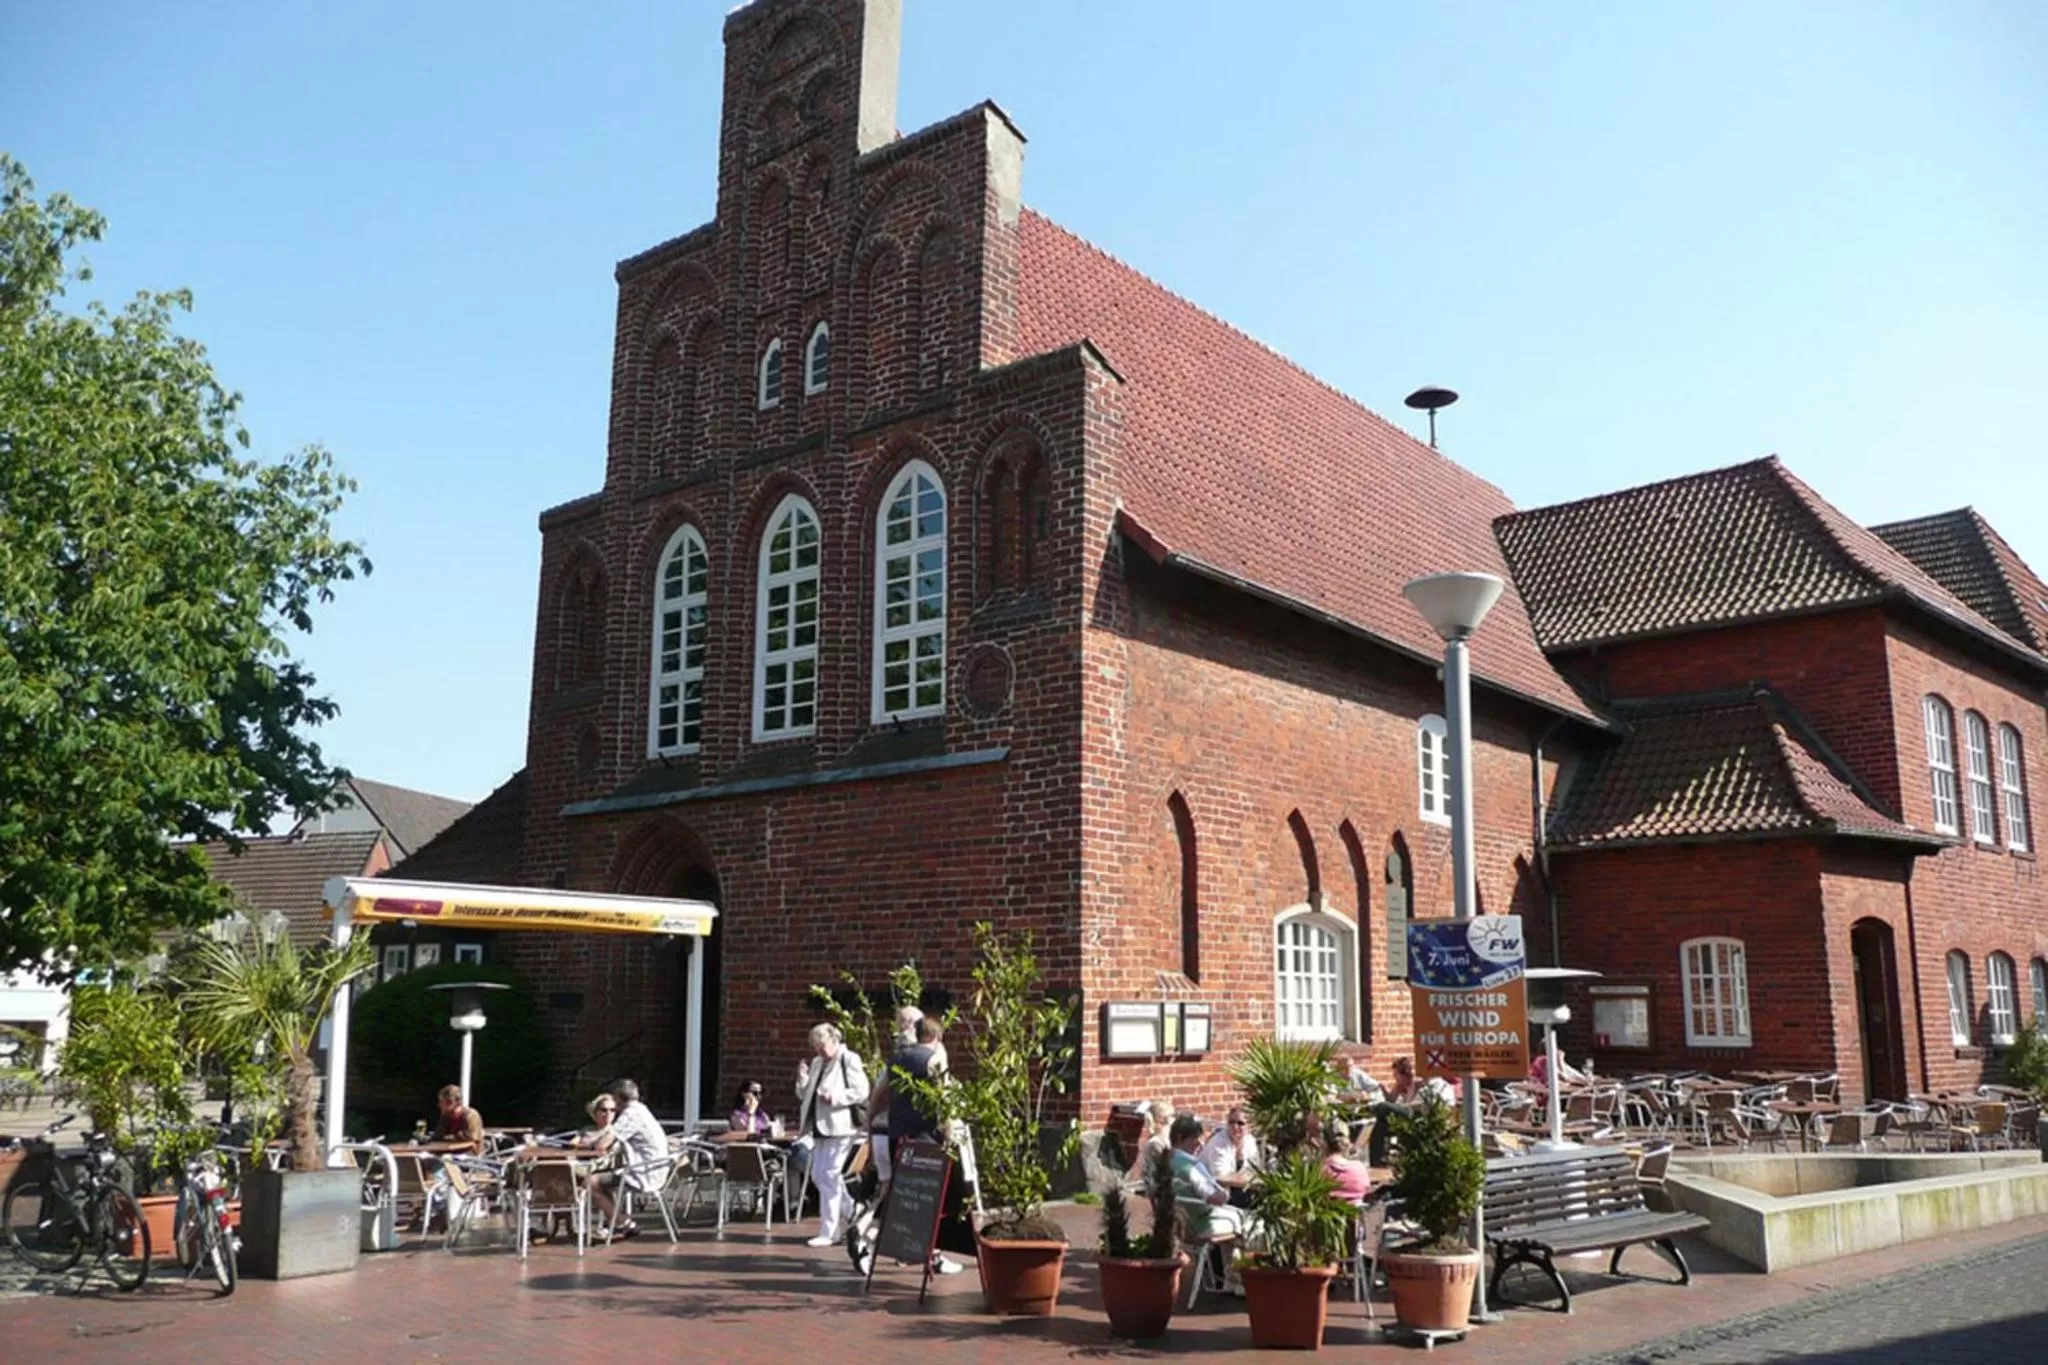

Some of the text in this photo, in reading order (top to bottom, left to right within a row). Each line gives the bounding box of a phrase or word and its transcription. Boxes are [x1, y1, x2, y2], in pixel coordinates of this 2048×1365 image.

[1488, 938, 1520, 951] FW
[1427, 952, 1470, 966] 7. Juni
[1428, 992, 1508, 1007] FRISCHER
[1437, 1010, 1501, 1028] WIND
[1420, 1030, 1520, 1046] FÜR EUROPA
